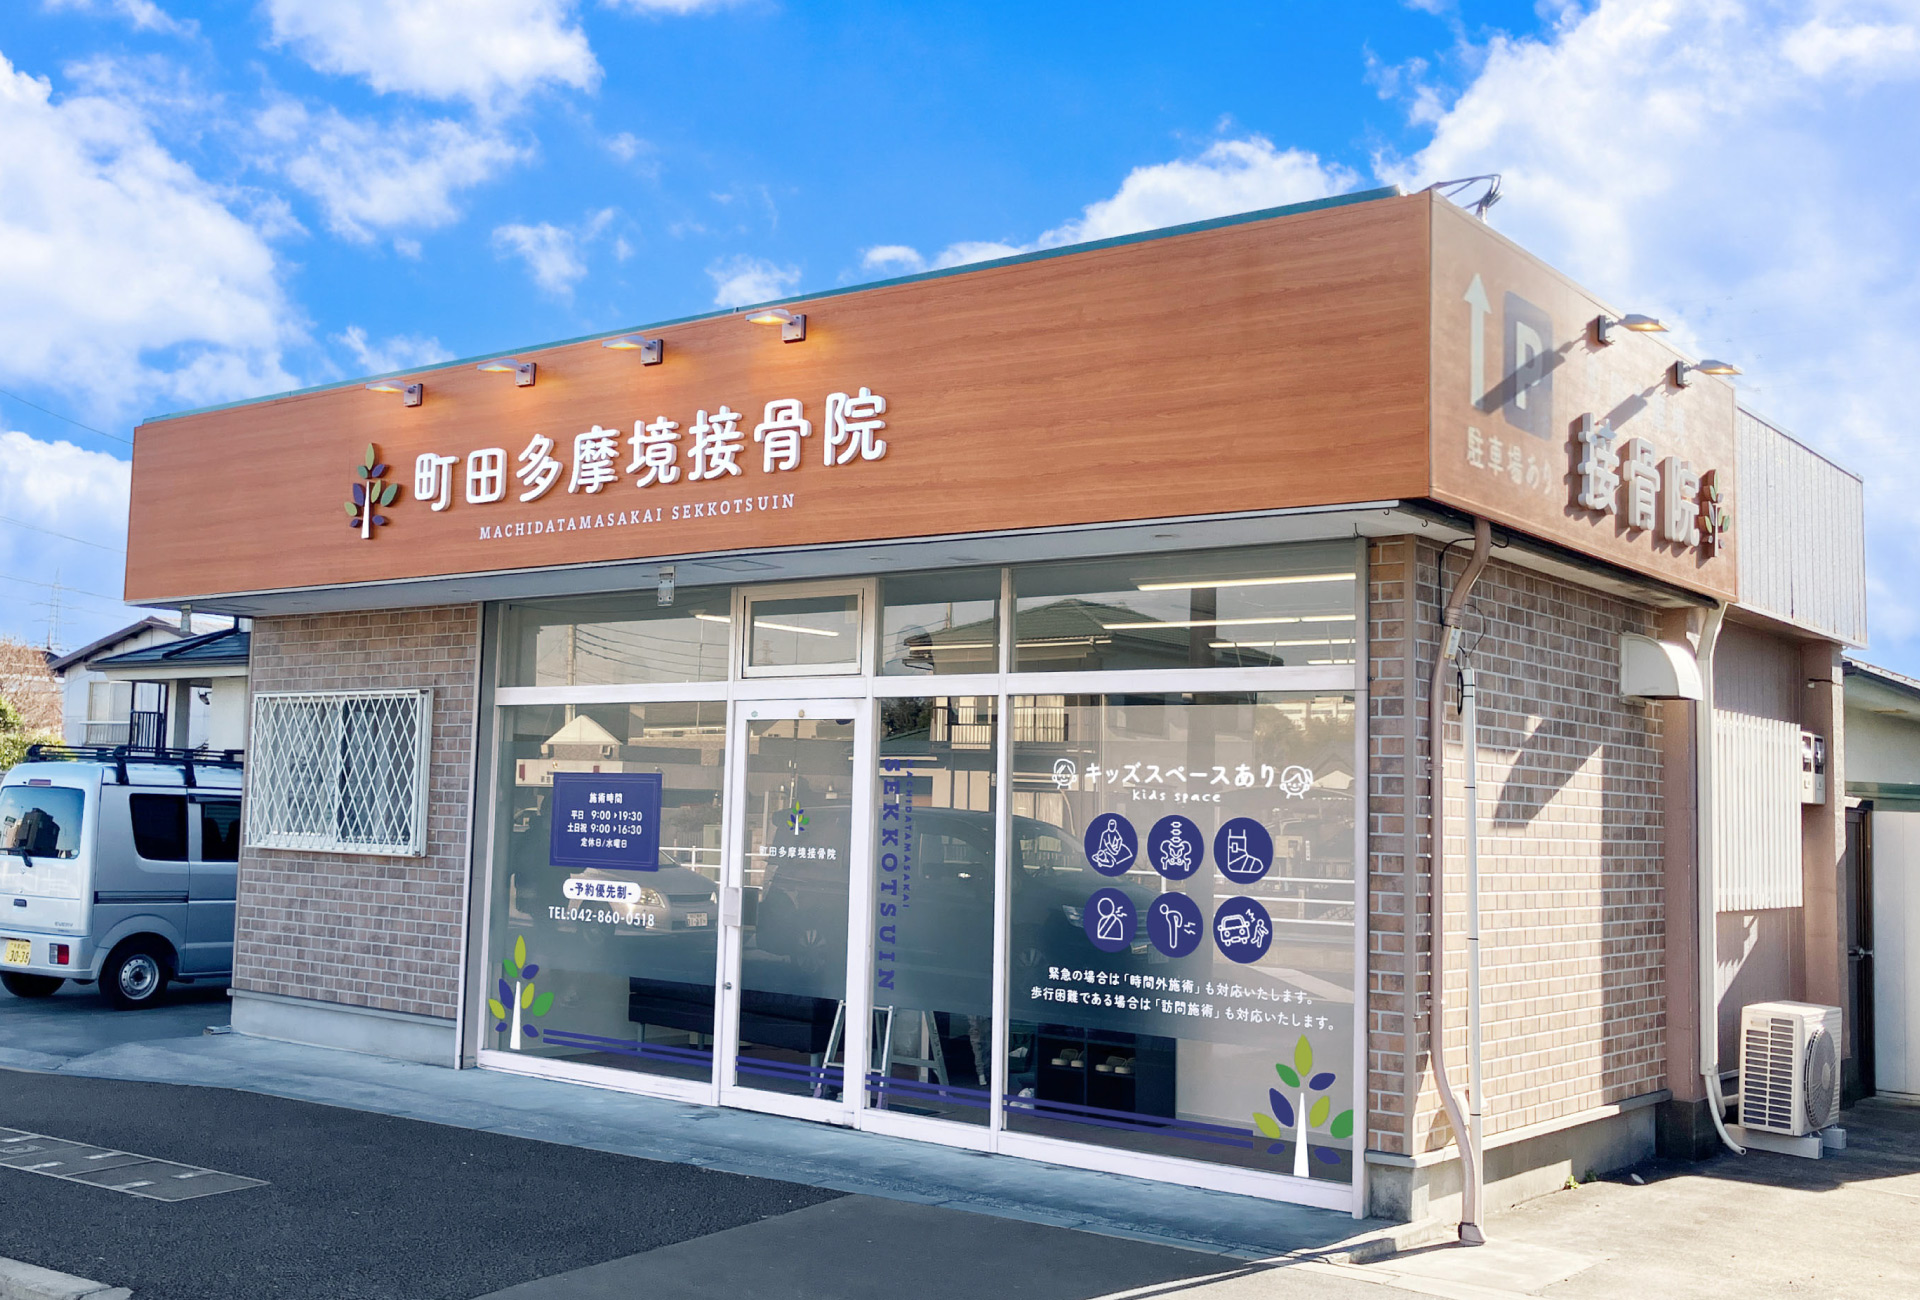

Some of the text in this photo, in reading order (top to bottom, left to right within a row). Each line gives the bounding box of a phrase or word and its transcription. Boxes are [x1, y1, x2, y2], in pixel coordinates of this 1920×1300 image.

[1515, 320, 1544, 411] P
[414, 387, 887, 512] 町田多摩境接骨院
[1467, 426, 1551, 496] 駐車場あり
[1578, 412, 1700, 547] 接骨院
[479, 493, 795, 540] MACHIDATAMASAKAI SEKKOTSUIN
[1084, 761, 1276, 788] キッズスペースあり
[589, 792, 623, 804] 施術時間
[1132, 788, 1222, 804] kids space
[567, 822, 642, 835] 土日祝 9:00 16:30
[571, 810, 643, 821] 平日 9:00 19:30
[580, 837, 628, 849] 定休日/水曜日
[878, 758, 900, 990] SEKKOTSUIN
[548, 906, 656, 927] TEL:042-860-0518
